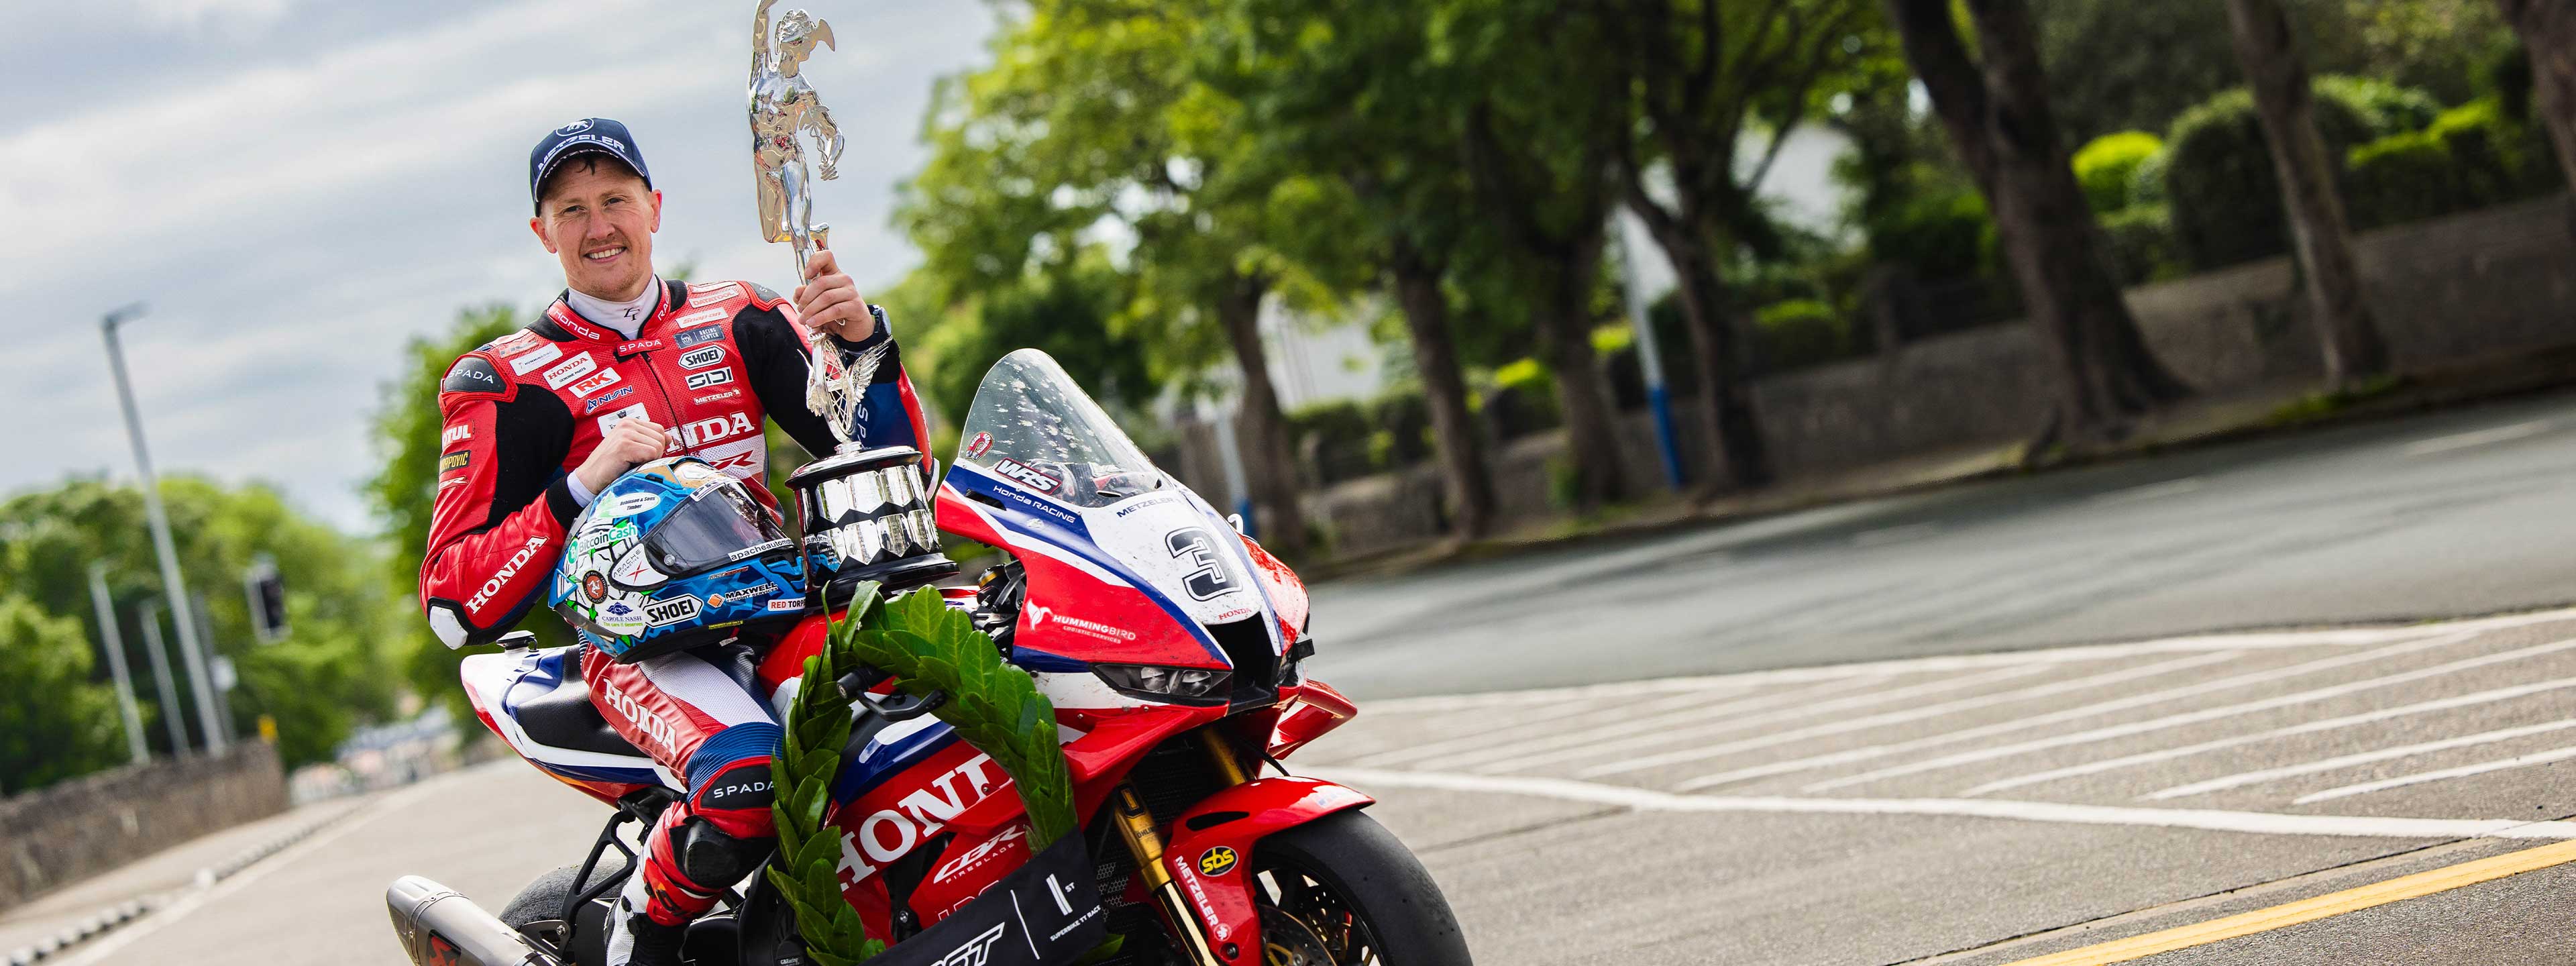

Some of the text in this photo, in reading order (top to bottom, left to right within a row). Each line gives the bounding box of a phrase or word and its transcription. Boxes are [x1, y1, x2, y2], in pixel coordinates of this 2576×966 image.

[554, 309, 600, 340] Honda
[682, 311, 722, 325] Snap-on
[699, 327, 716, 335] RACING
[619, 339, 663, 353] SPADA
[547, 357, 588, 380] HONDA
[685, 349, 719, 366] SHOEI
[448, 369, 494, 384] SPADA
[559, 367, 586, 383] GENUINE PARTS
[576, 372, 612, 392] RK
[688, 368, 733, 388] SIDI
[694, 391, 733, 404] METZELER
[665, 412, 755, 454] NDA
[996, 459, 1059, 491] WRS
[993, 485, 1076, 524] Honda RACING
[1116, 497, 1174, 518] METZELER
[465, 537, 549, 614] HONDA
[1165, 527, 1243, 602] 3
[726, 582, 777, 598] MAXWELL
[647, 599, 695, 623] SHOEI
[1218, 607, 1252, 620] HONDA
[1052, 614, 1136, 641] HUMMINGBIRD
[1063, 625, 1122, 644] LOGISTIC SERVICES
[604, 678, 678, 758] HONDA
[946, 843, 1015, 884] FIREBLADE
[1201, 848, 1234, 873] sbs
[1065, 881, 1075, 892] ST
[1175, 855, 1219, 926] METZELER
[1050, 904, 1101, 941] SUPERBIKE TT RACE
